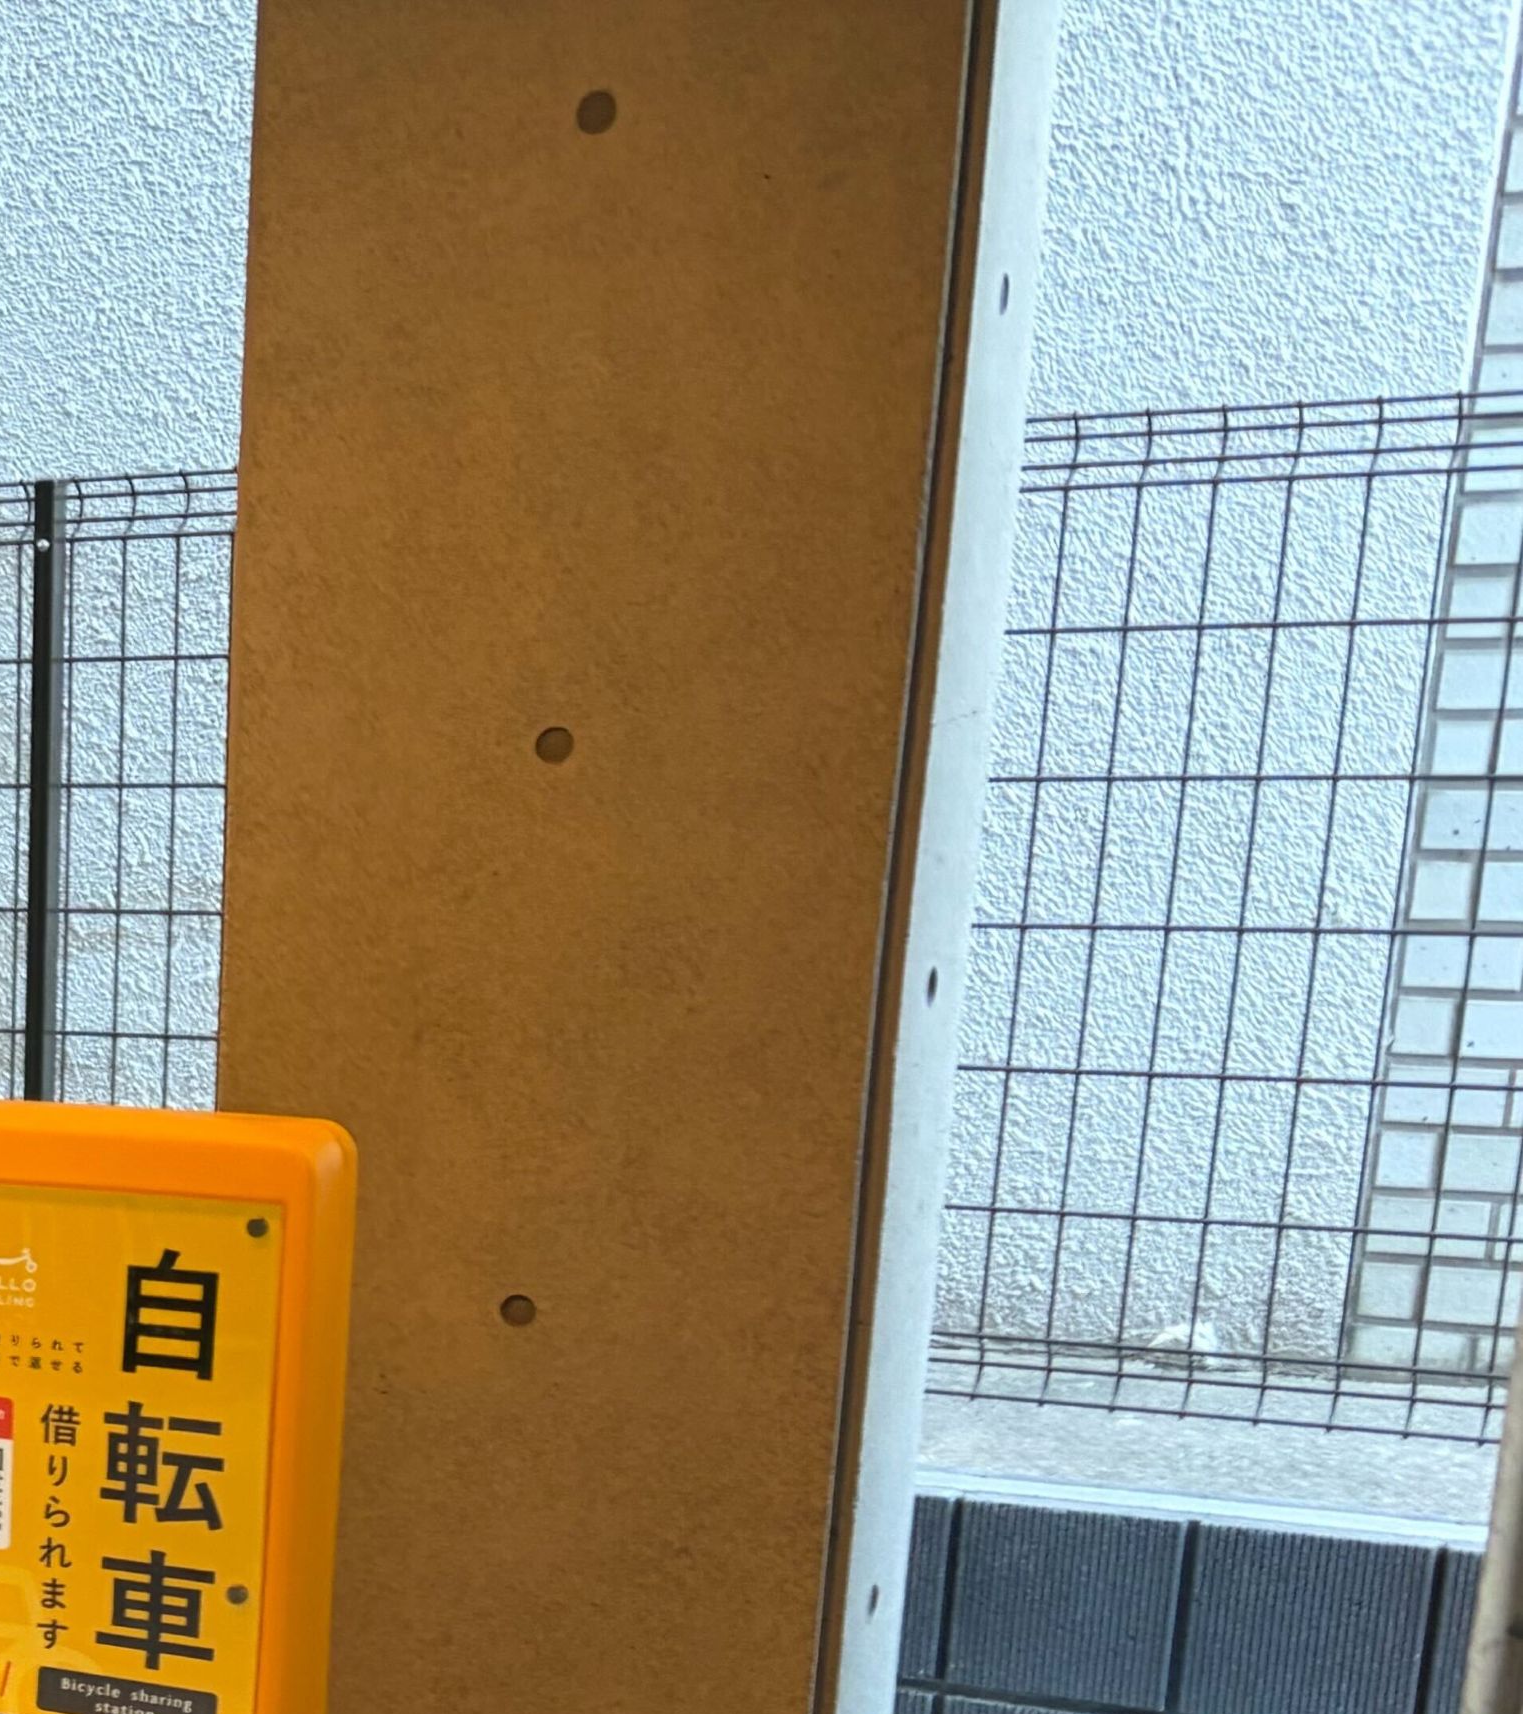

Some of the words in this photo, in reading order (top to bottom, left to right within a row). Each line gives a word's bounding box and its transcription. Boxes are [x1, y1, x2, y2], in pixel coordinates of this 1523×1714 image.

[36, 1403, 82, 1650] 借りられます
[94, 1247, 225, 1671] 自転車
[60, 1677, 121, 1698] Bicycle
[130, 1688, 194, 1714] sharing
